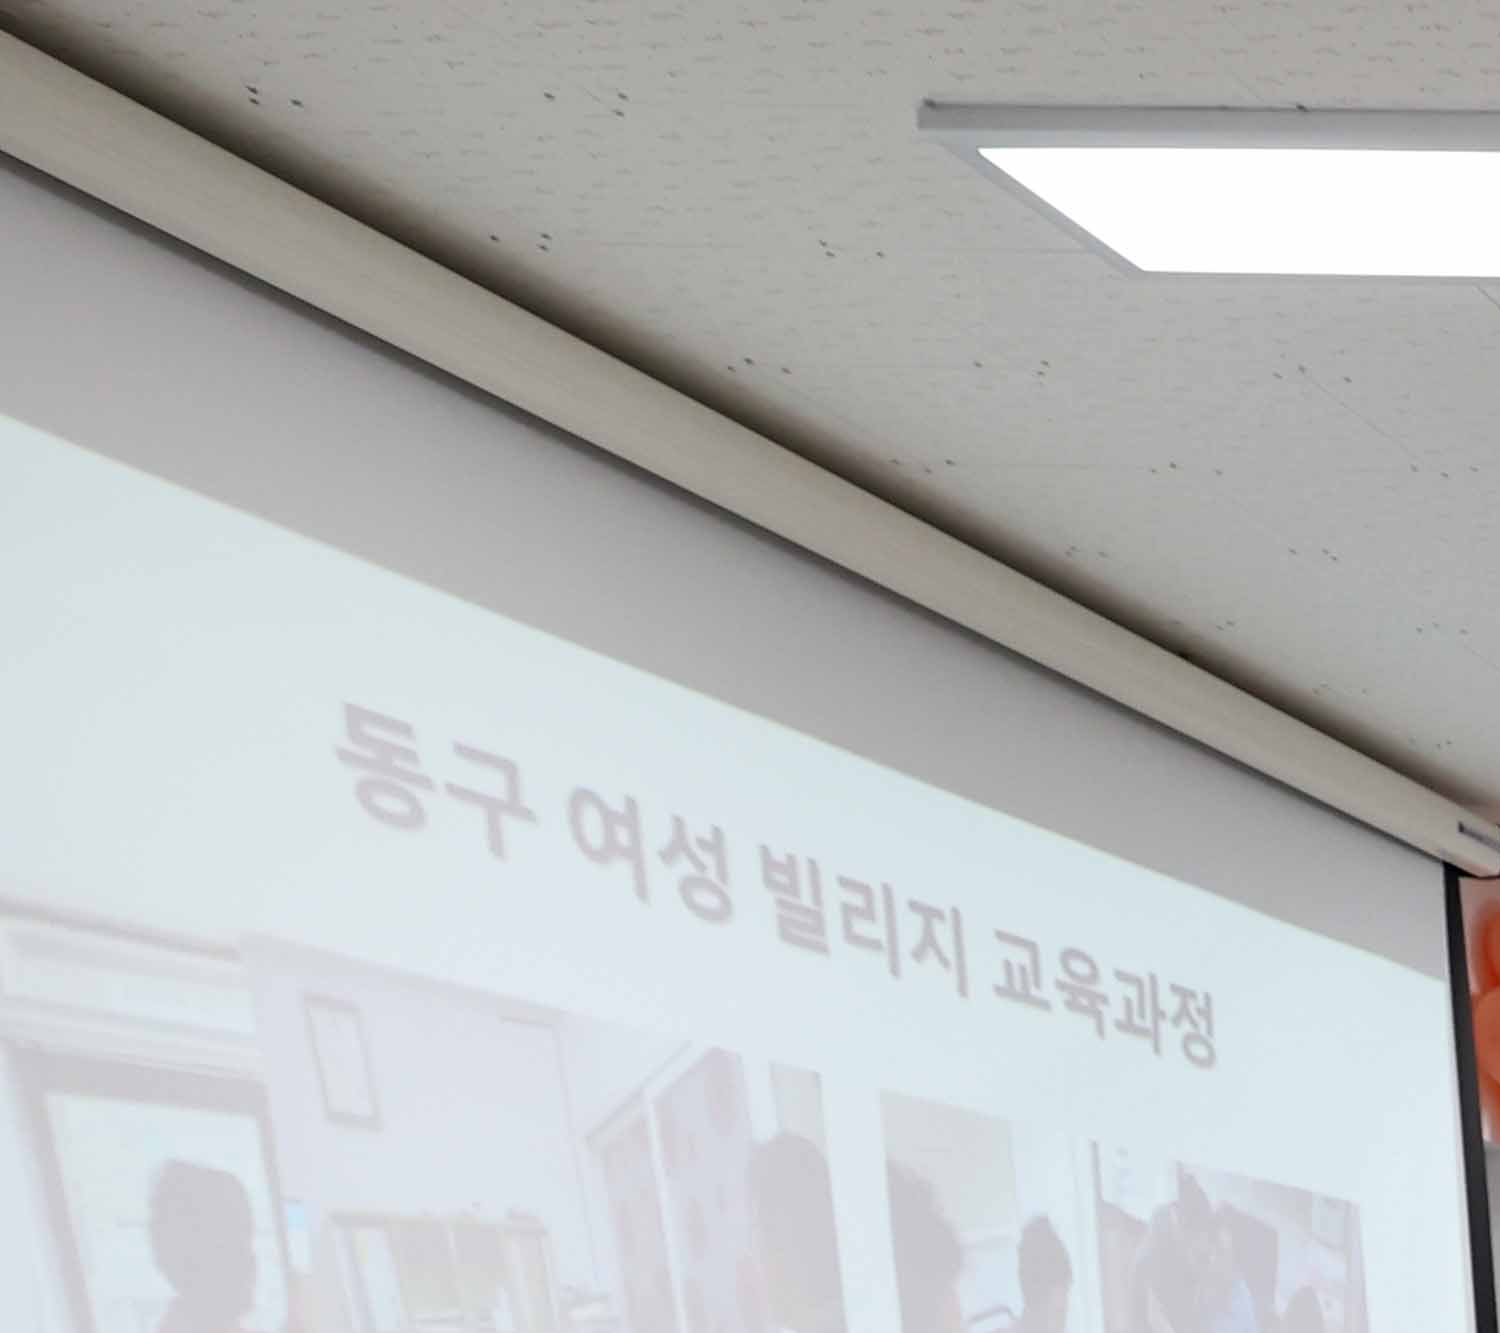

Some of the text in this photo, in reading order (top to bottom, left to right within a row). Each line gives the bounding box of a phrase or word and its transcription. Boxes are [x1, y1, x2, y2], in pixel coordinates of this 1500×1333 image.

[334, 702, 1220, 1070] 동구 여성 빌리지 교육과정
